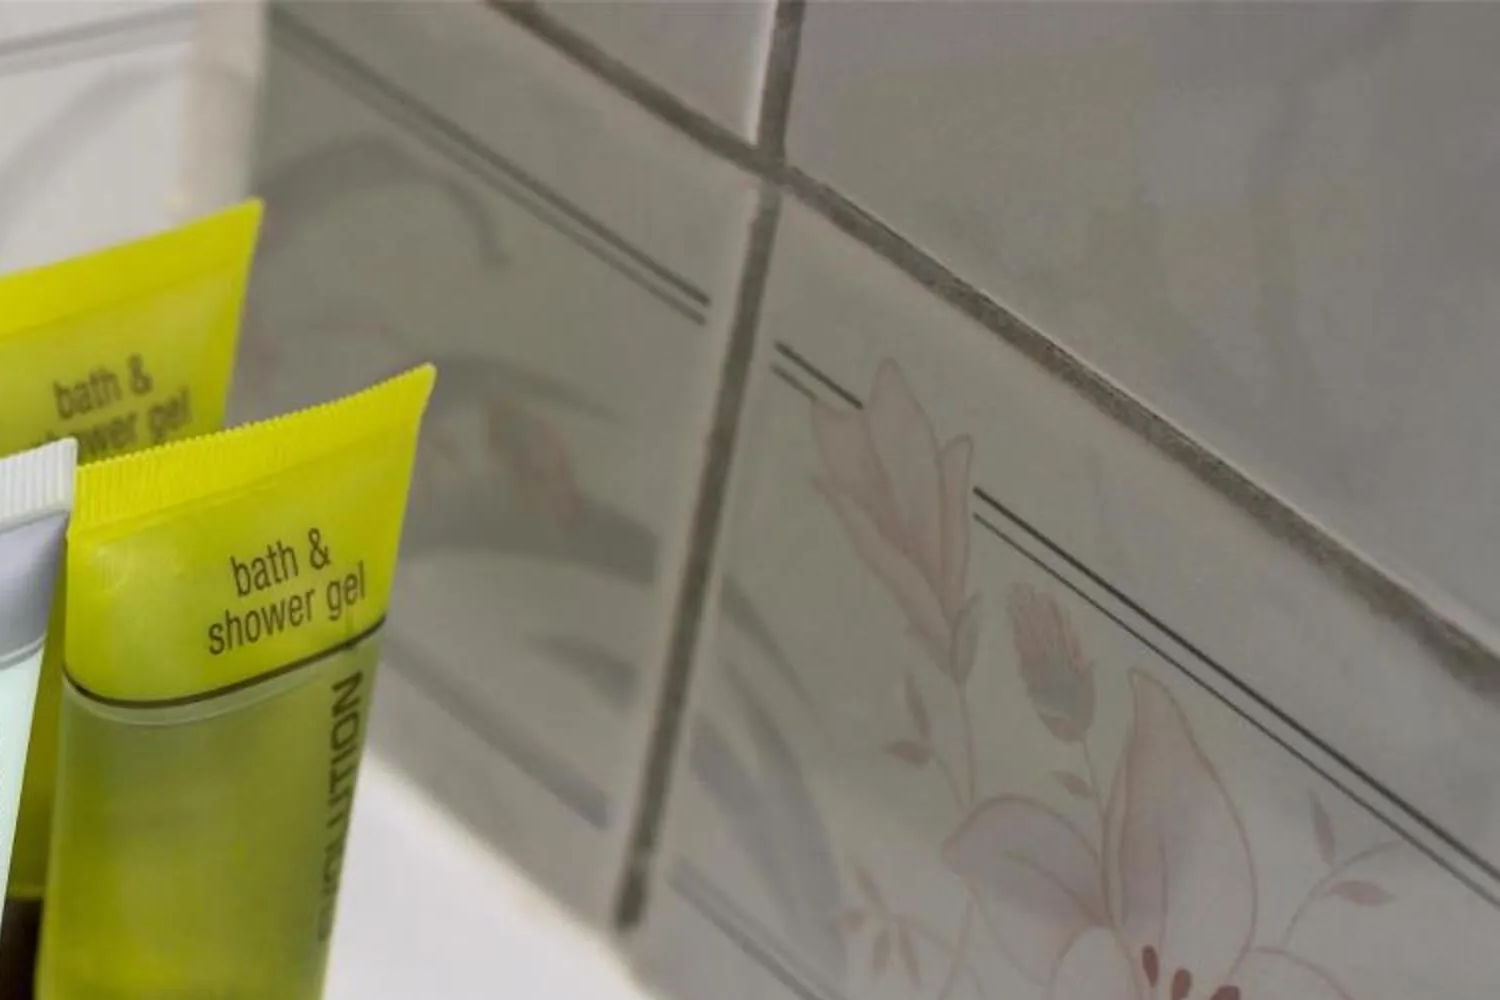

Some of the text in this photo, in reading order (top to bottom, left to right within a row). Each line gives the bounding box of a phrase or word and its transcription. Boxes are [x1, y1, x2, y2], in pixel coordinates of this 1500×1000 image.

[230, 528, 331, 597] bath &
[208, 561, 365, 655] shower gel
